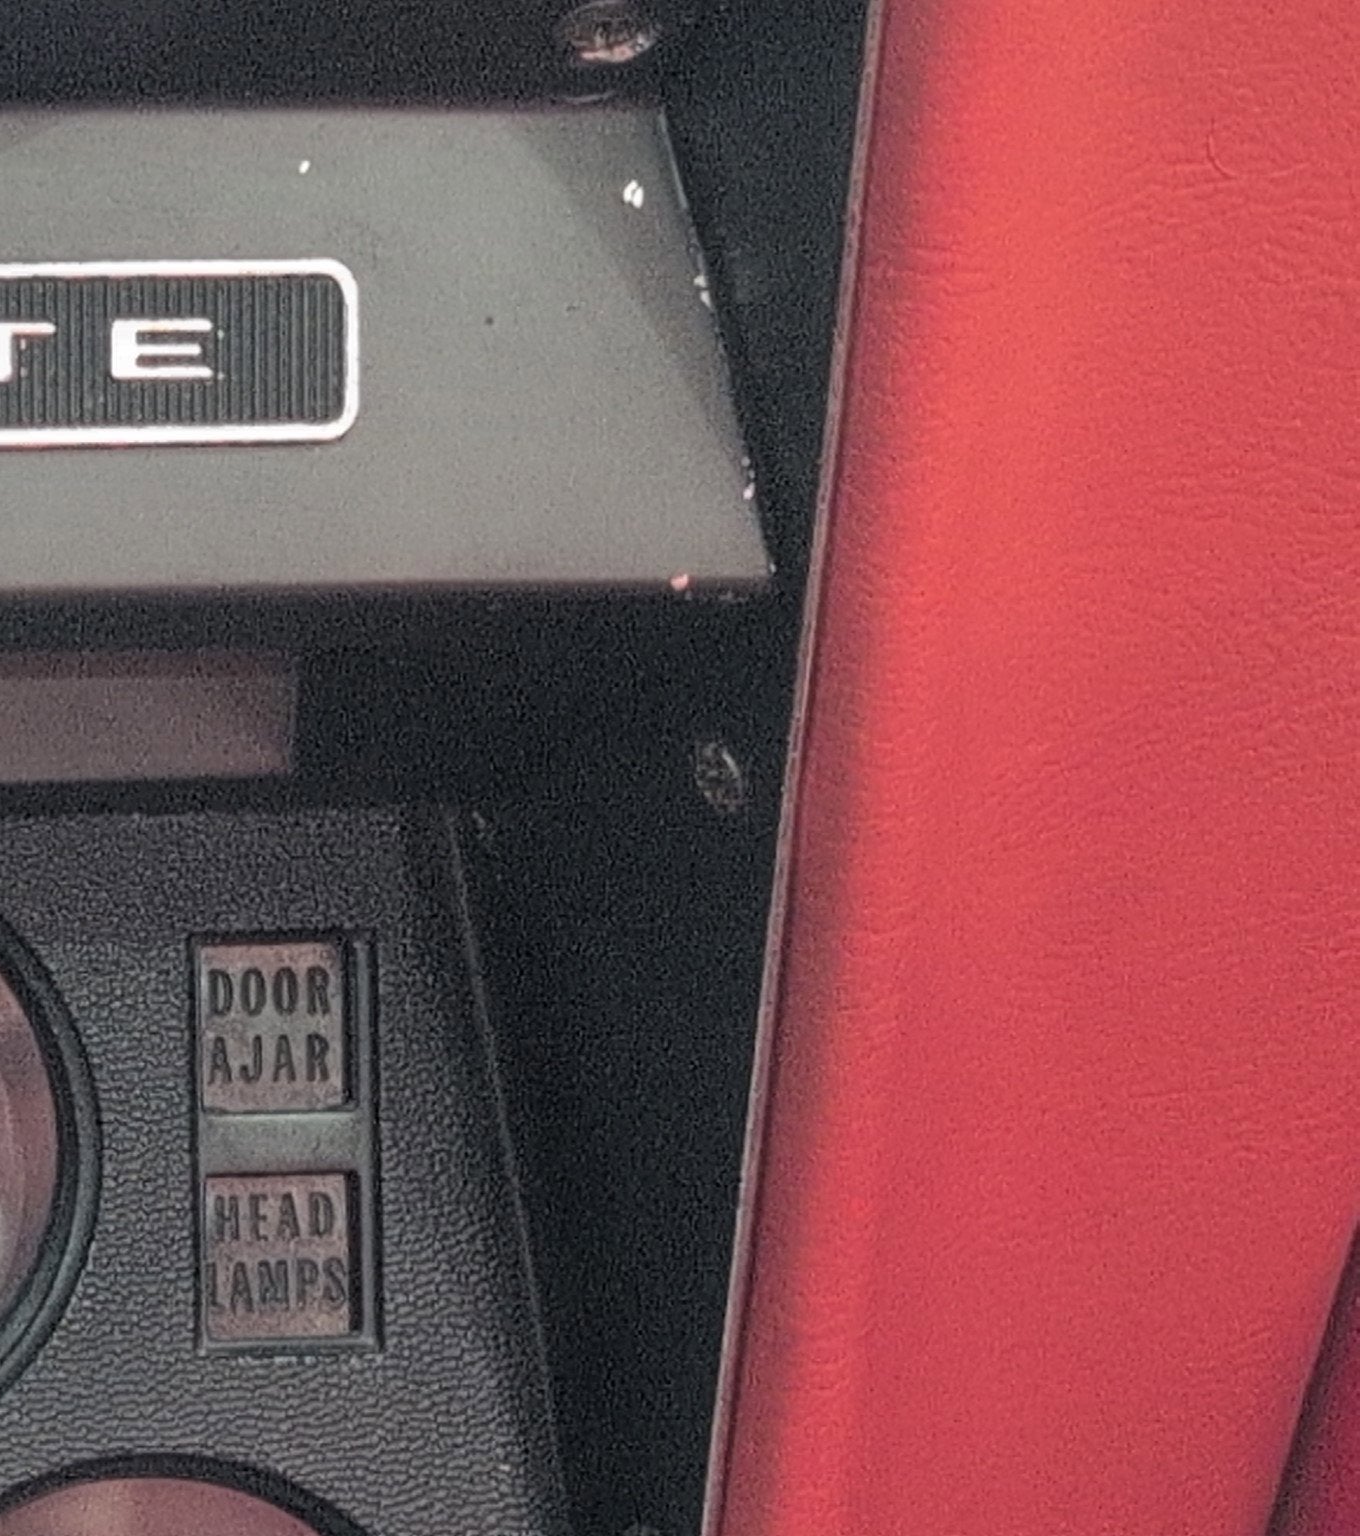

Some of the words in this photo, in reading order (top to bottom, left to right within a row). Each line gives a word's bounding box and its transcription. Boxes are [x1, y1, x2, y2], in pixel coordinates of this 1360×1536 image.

[207, 966, 332, 1018] DOOR
[207, 1033, 332, 1086] AJAR
[212, 1191, 336, 1243] HEAD
[206, 1257, 347, 1315] LAMPS
